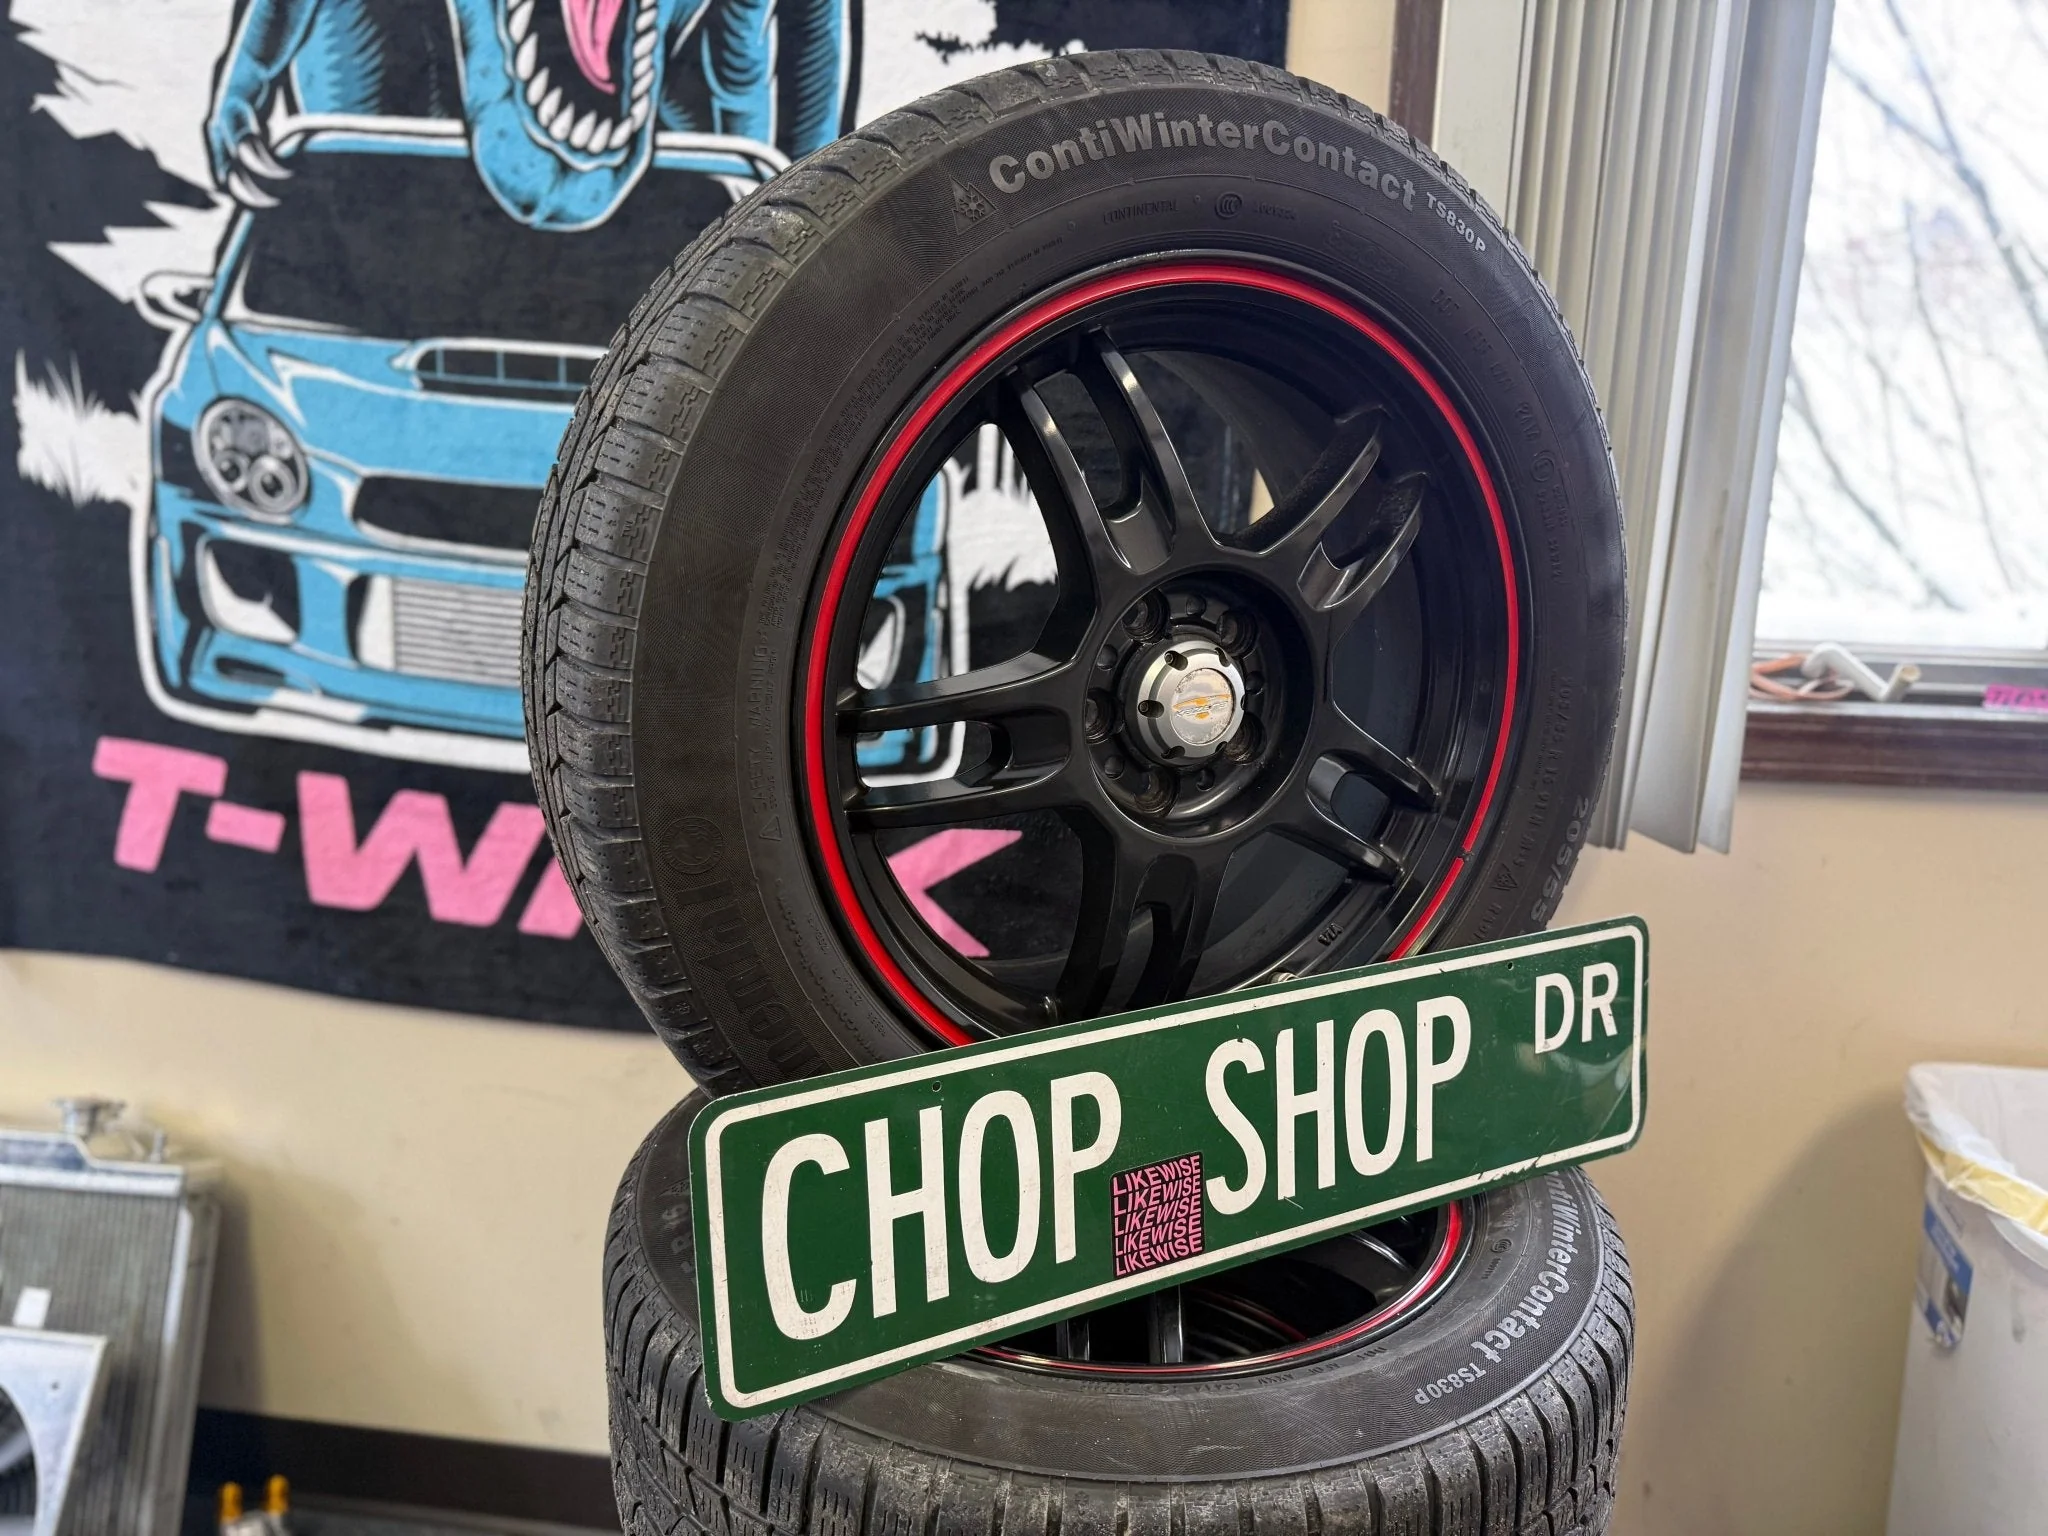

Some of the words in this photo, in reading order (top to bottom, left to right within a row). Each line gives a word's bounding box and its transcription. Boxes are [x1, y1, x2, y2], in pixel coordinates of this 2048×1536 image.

[988, 112, 1417, 213] ContiWinterContact
[1426, 191, 1488, 254] TS830P
[1102, 200, 1180, 226] CONTINENTAL
[1531, 796, 1588, 923] 205/55
[762, 1071, 1121, 1340] CHOP
[1205, 995, 1472, 1215] SHOP
[1534, 962, 1619, 1054] DR
[1113, 1155, 1200, 1196] LIKEWISE
[1114, 1175, 1200, 1216] LIKEWISE
[1114, 1195, 1201, 1236] LIKEWISE
[1115, 1214, 1202, 1256] LIKEWISE
[1116, 1233, 1203, 1276] LIKEWISE
[1470, 1172, 1582, 1364] ntiWinterContact
[1414, 1362, 1487, 1405] TS830P
